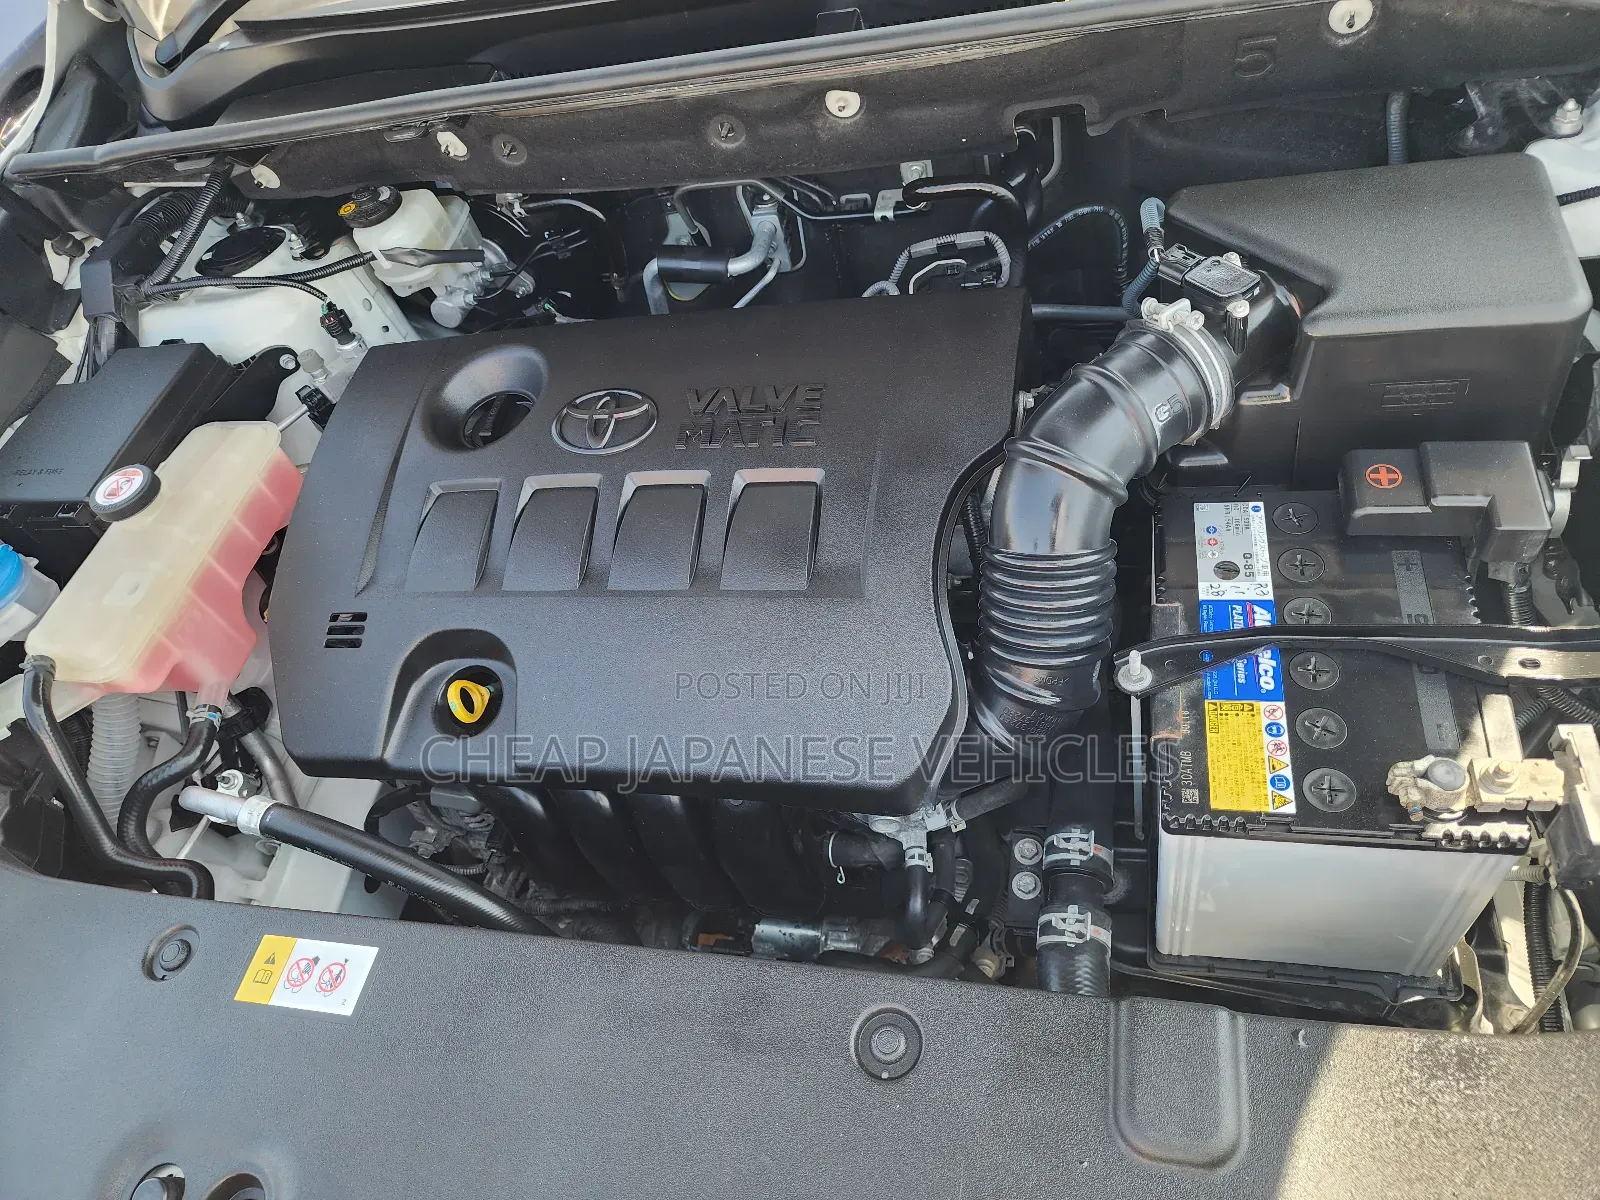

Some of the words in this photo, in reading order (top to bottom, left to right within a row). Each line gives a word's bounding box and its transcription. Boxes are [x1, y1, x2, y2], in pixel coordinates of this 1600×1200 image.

[685, 383, 825, 416] VALVE
[675, 415, 820, 450] MATIC
[1242, 552, 1255, 578] Q-85
[1208, 710, 1219, 733] DANGER
